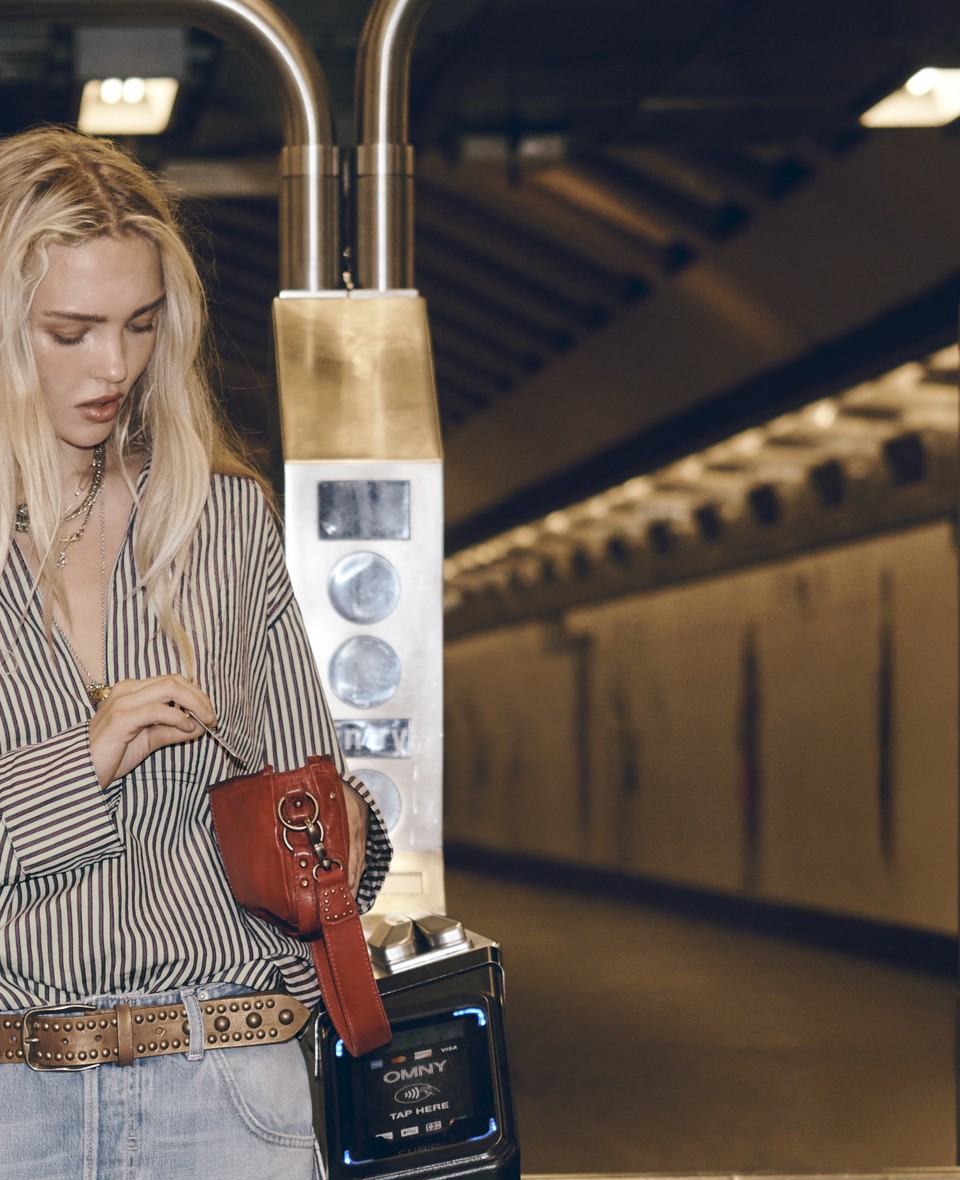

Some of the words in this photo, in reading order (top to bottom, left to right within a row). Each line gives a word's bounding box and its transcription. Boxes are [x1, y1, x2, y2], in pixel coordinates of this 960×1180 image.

[440, 1045, 458, 1053] VISA
[383, 1060, 447, 1084] OMNY
[390, 1109, 412, 1121] TAP
[415, 1102, 449, 1115] HERE
